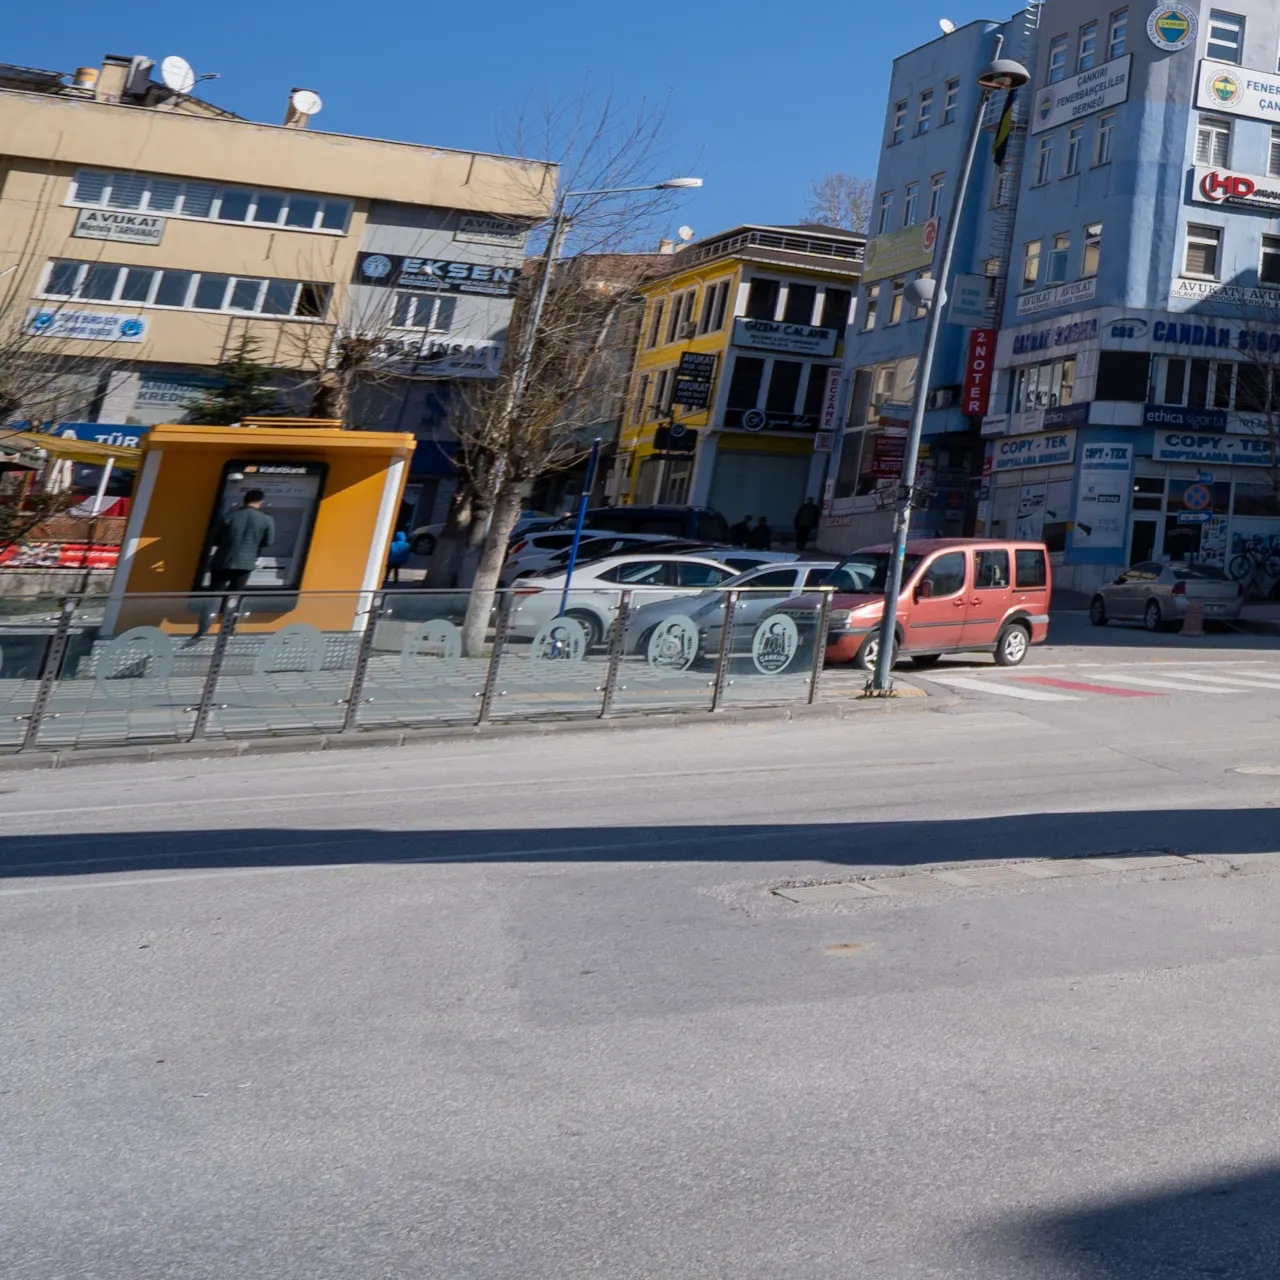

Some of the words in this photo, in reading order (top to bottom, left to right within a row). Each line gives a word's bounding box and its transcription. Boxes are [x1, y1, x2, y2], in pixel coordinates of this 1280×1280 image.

[1077, 67, 1108, 88] ÇANKIRI
[1056, 74, 1125, 108] FENERBAHÇELİLER
[1072, 95, 1105, 116] DERNEĞİ
[1210, 173, 1255, 197] HD
[85, 212, 161, 228] AVUKAT
[402, 258, 514, 282] EKSEN
[1061, 281, 1093, 297] AVUKAT
[1171, 290, 1205, 300] DİLAVER
[1179, 281, 1239, 297] AVUKAT
[1022, 291, 1052, 307] AVUKAT
[1153, 320, 1230, 348] CANDAN
[682, 353, 715, 365] AVUKAT
[140, 381, 197, 393] ANIND
[677, 380, 709, 392] AVUKAT
[968, 346, 986, 412] NOTER
[824, 378, 839, 427] ECZANE
[1146, 409, 1183, 424] ethica
[1185, 412, 1225, 429] sigorta
[95, 431, 140, 448] TÜR
[1001, 439, 1034, 455] COPY
[1045, 435, 1068, 449] TEK
[1165, 434, 1223, 450] COPY
[1085, 447, 1105, 460] COPY
[1110, 447, 1129, 460] TEK
